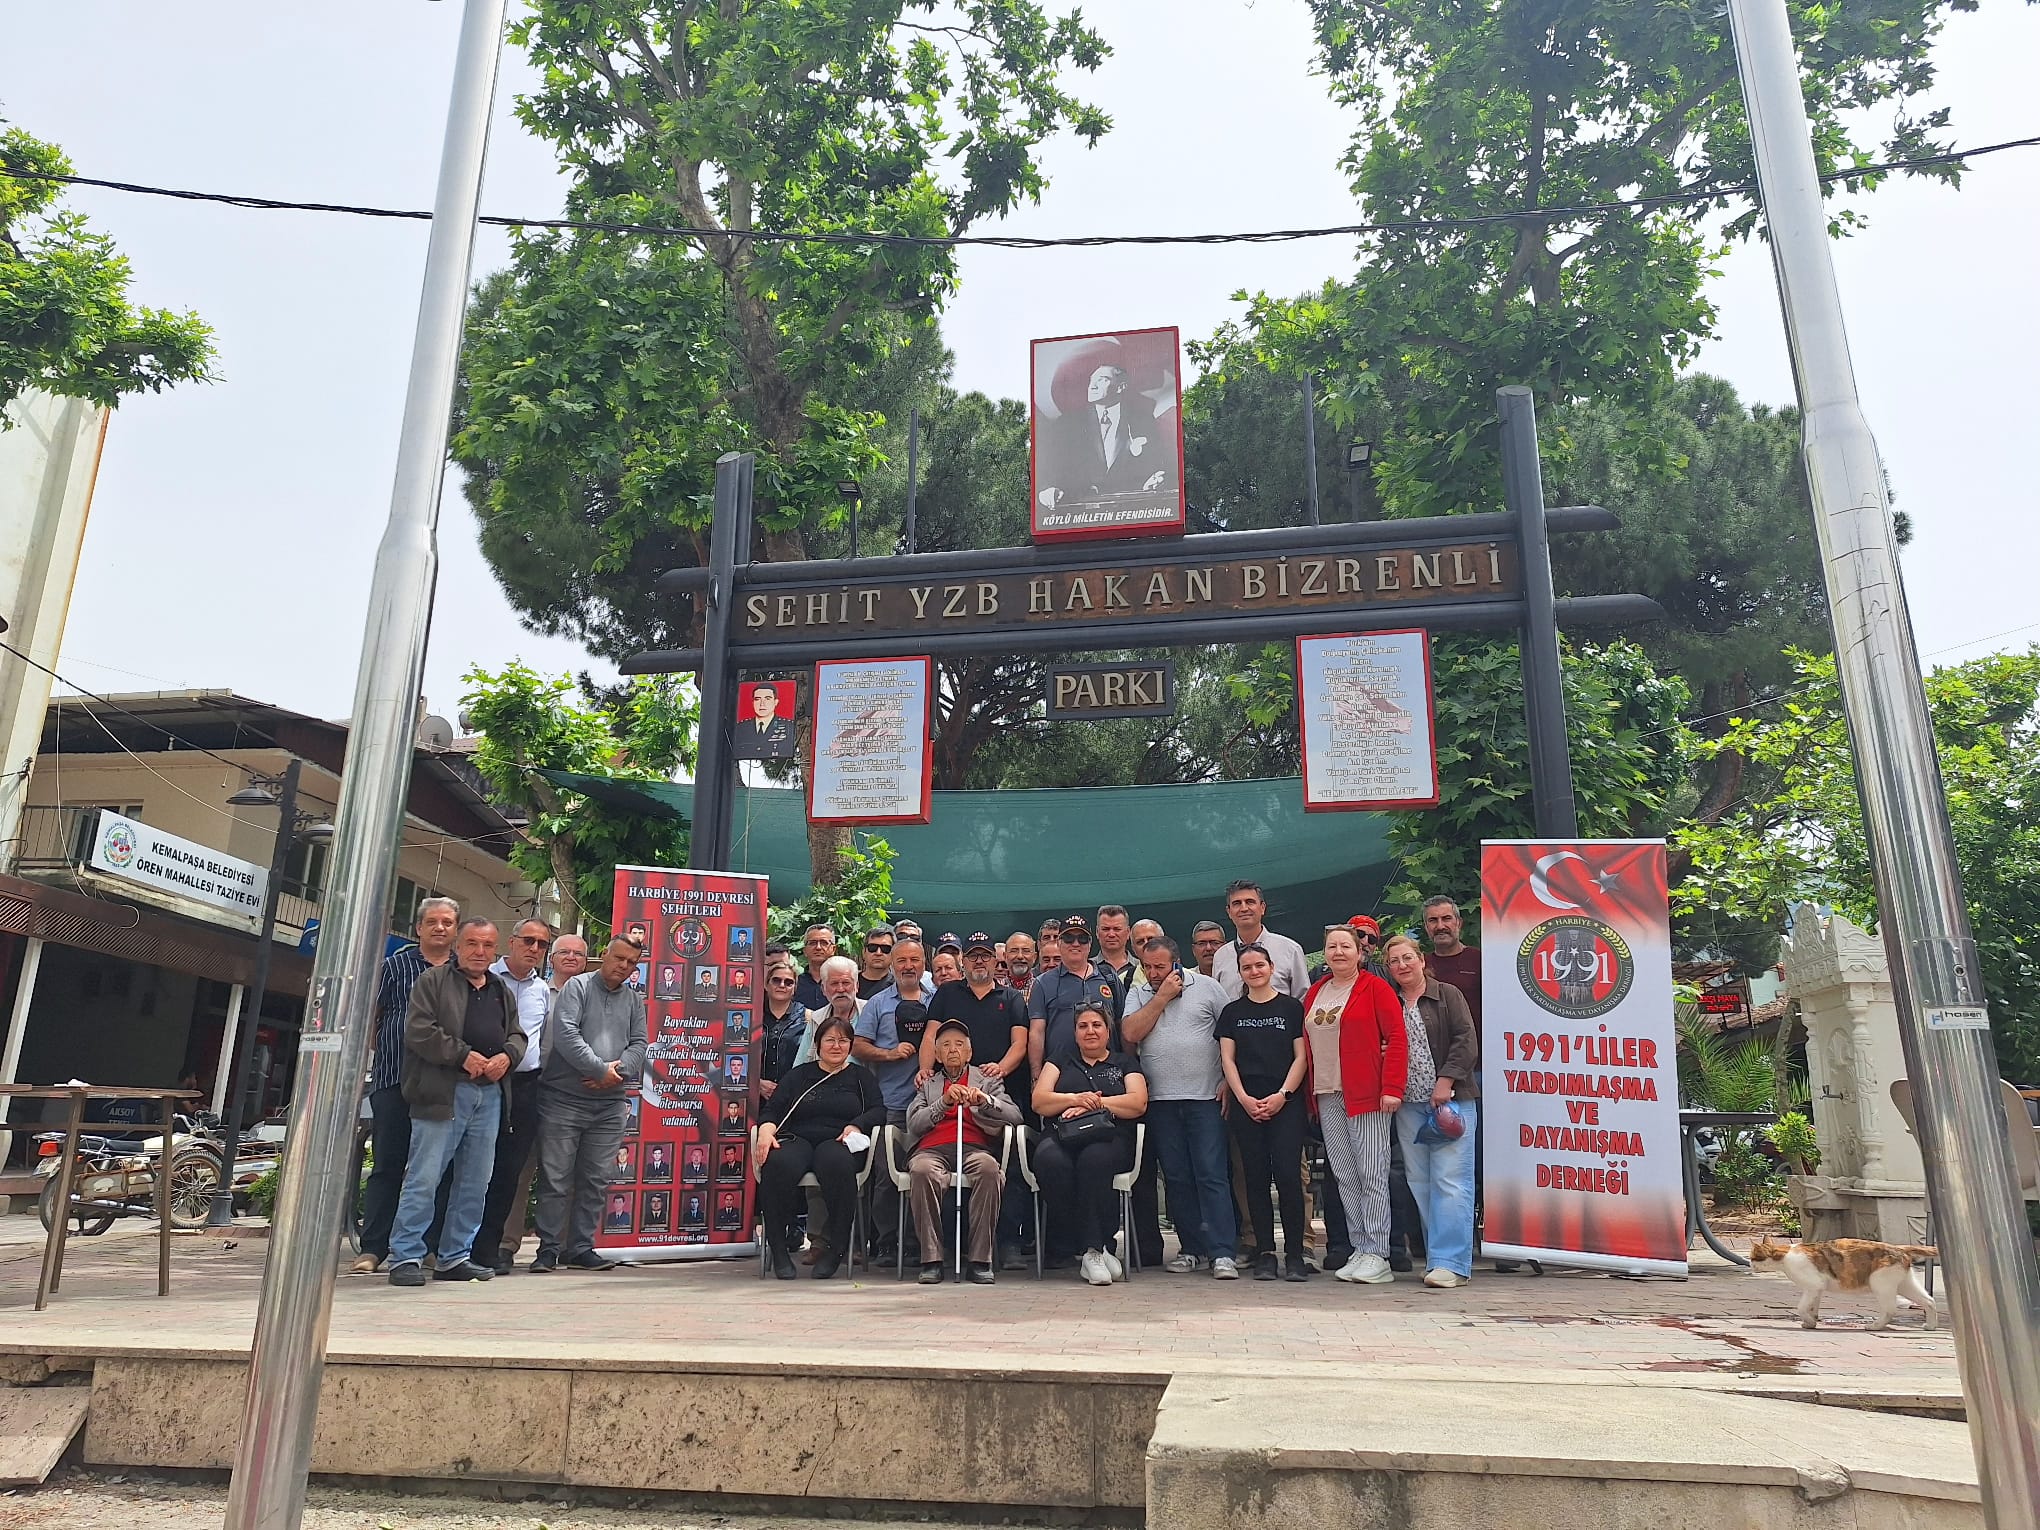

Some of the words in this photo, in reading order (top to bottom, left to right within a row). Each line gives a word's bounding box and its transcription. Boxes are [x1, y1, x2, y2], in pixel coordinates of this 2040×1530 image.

[1042, 512, 1071, 526] KÖYLÜ
[1072, 510, 1114, 524] MİLLETİN
[1115, 507, 1174, 521] EFENDİSİDİR.
[909, 583, 999, 619] YZB
[1028, 567, 1213, 614] HAKAN
[1241, 543, 1503, 600] BİZRENLİ
[1054, 669, 1167, 710] PARKI
[151, 841, 205, 871] KEMALPAŞA
[206, 861, 255, 887] BELEDİYESİ
[136, 856, 163, 877] ÖREN
[164, 867, 215, 893] MAHALLESİ
[216, 884, 245, 904] TAZİYE
[246, 894, 261, 908] EVİ
[628, 886, 680, 900] HARBİYE
[683, 890, 704, 901] 1991
[707, 892, 754, 905] DEVRESİ
[661, 903, 722, 917] ŞEHİTLERİ
[1555, 918, 1591, 927] HARBİYE
[676, 930, 704, 946] 1991
[1537, 949, 1614, 984] 1991
[663, 1015, 708, 1030] Bayrakları
[687, 1035, 713, 1047] yapan
[1504, 1023, 1658, 1069] 1991'LİLER
[648, 1047, 689, 1060] üstündeki
[690, 1049, 719, 1060] kandır.
[668, 1063, 699, 1079] Toprak,
[653, 1081, 673, 1096] eğer
[674, 1081, 711, 1097] uğrunda
[1504, 1070, 1658, 1104] YARDIMLAŞMA
[680, 1101, 703, 1110] varsa
[1566, 1100, 1599, 1125] VE
[662, 1115, 698, 1127] vatandır.
[1519, 1124, 1645, 1159] DAYANIŞMA
[1536, 1160, 1629, 1195] DERNEĞİ
[638, 1233, 709, 1244] www.91devresi.org
